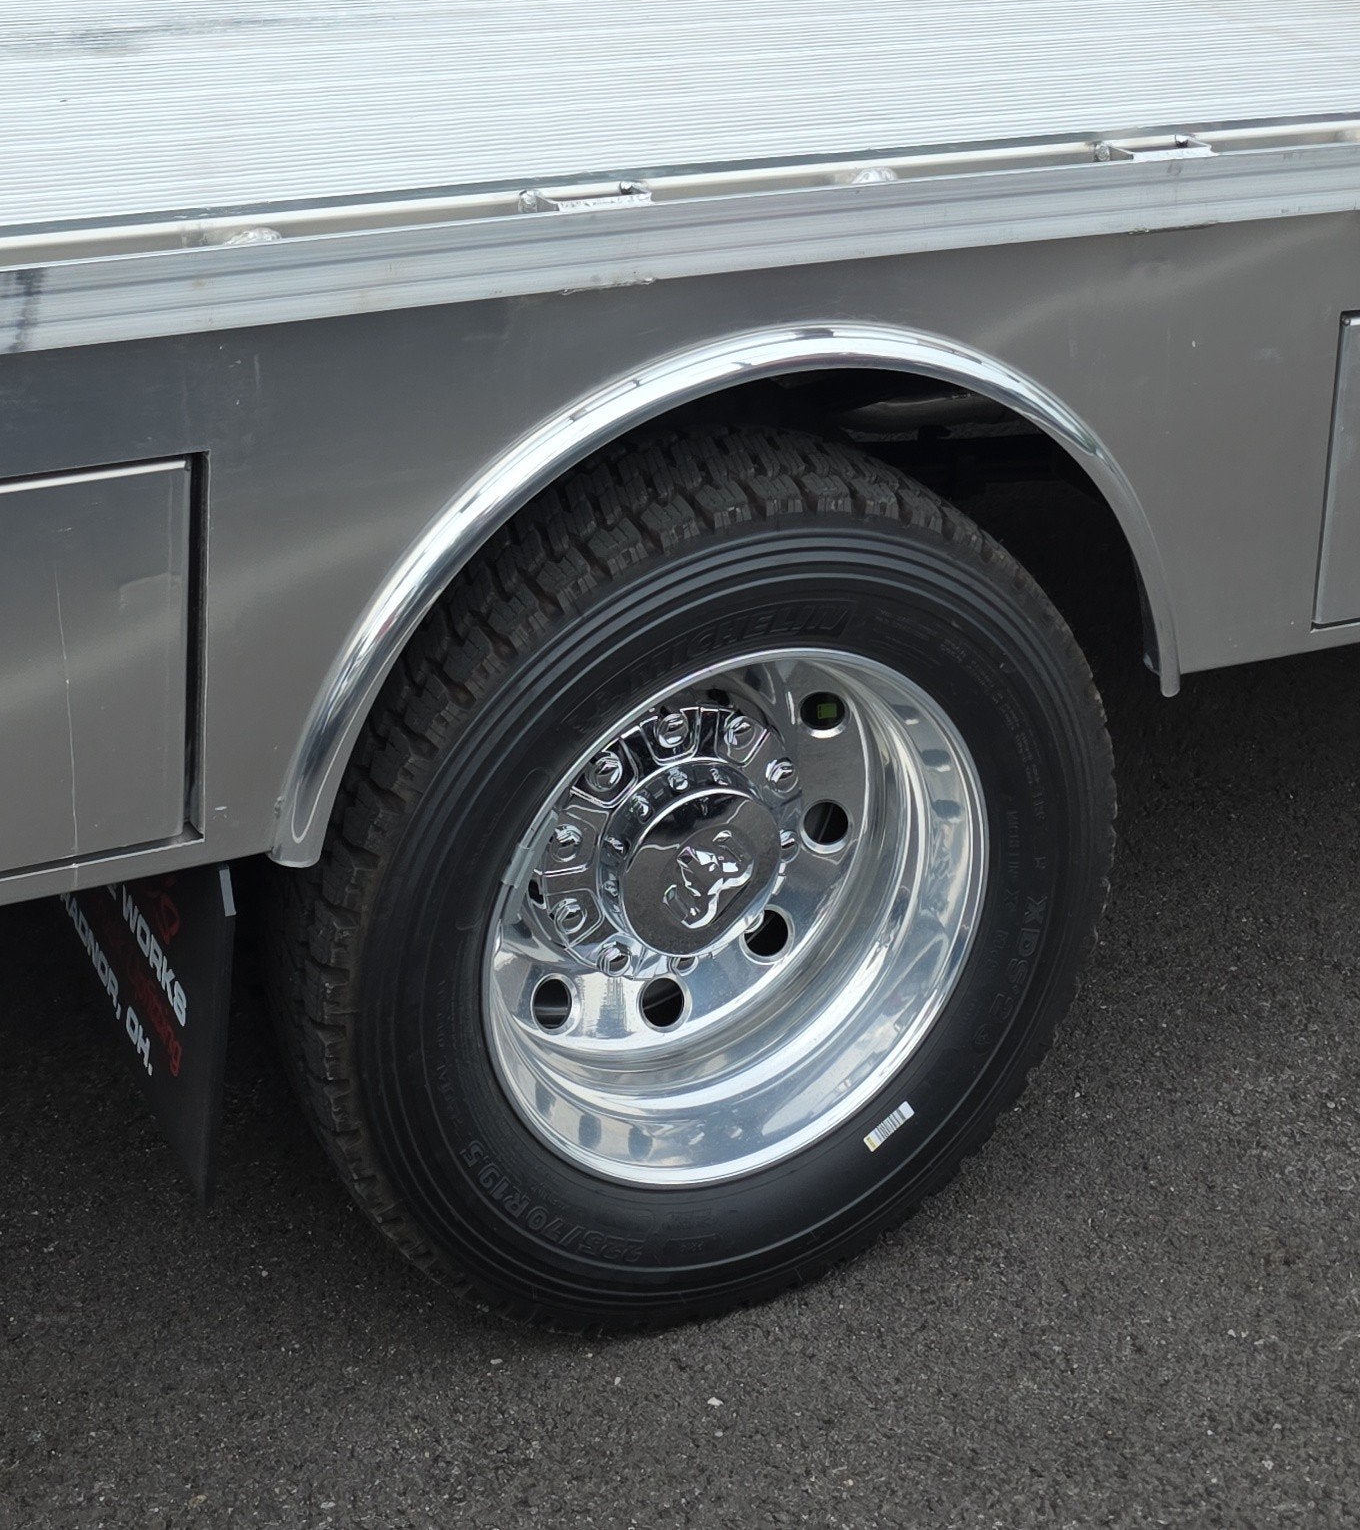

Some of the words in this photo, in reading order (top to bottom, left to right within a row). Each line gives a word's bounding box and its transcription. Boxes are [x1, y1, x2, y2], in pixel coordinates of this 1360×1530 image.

[628, 602, 851, 690] MICHELIN
[121, 884, 188, 1027] WORKS
[126, 1006, 154, 1077] OH.
